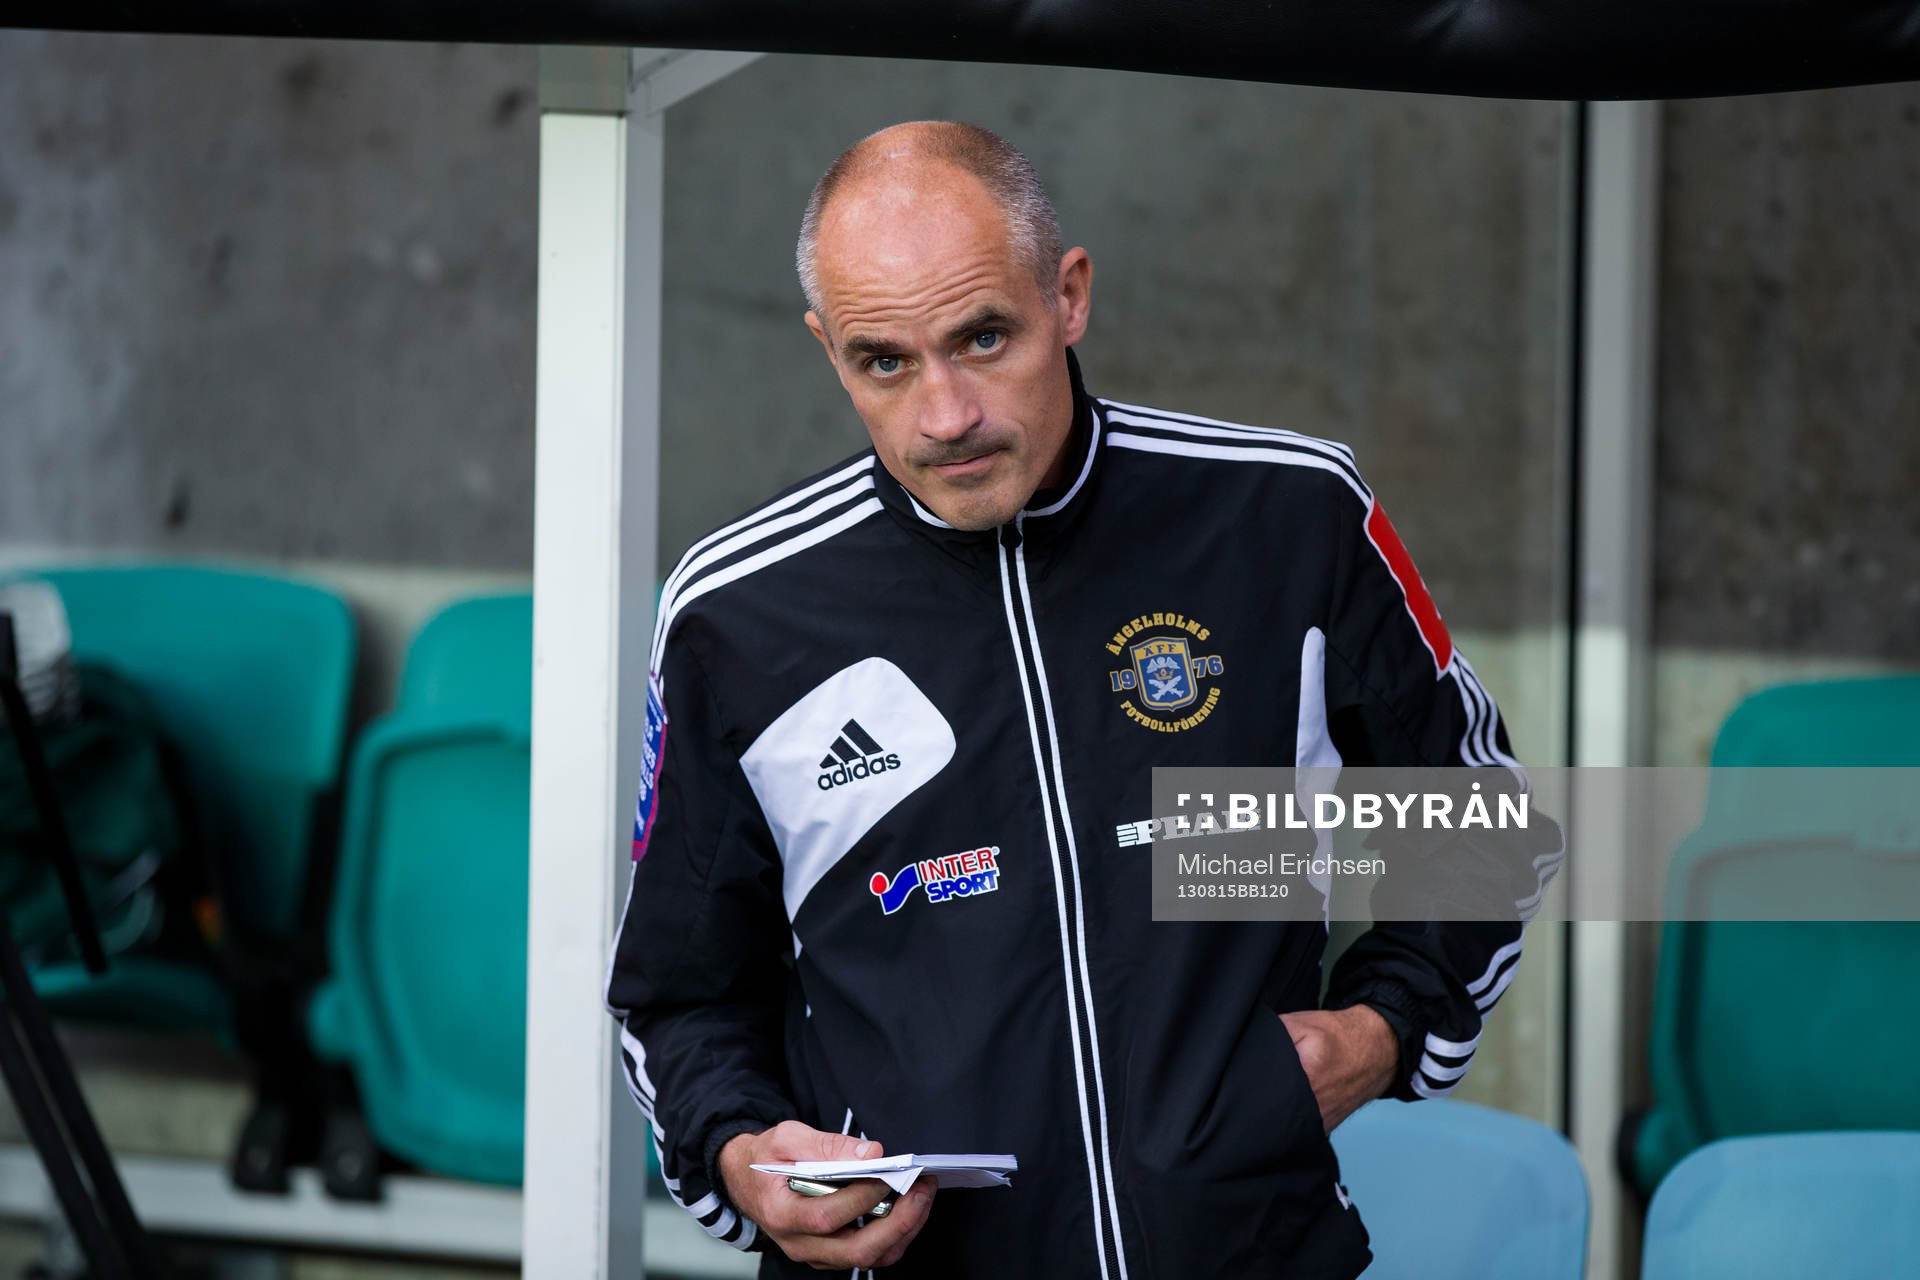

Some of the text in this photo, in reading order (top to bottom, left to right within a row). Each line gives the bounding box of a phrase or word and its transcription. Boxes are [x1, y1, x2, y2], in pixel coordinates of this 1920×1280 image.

[1106, 612, 1211, 656] ÄNGELHOLMS
[1110, 655, 1224, 692] 19 76
[1120, 687, 1221, 733] FOTBOLLFÖRENING
[817, 753, 902, 791] adidas
[919, 848, 995, 882] INTER
[926, 870, 998, 901] SPORT
